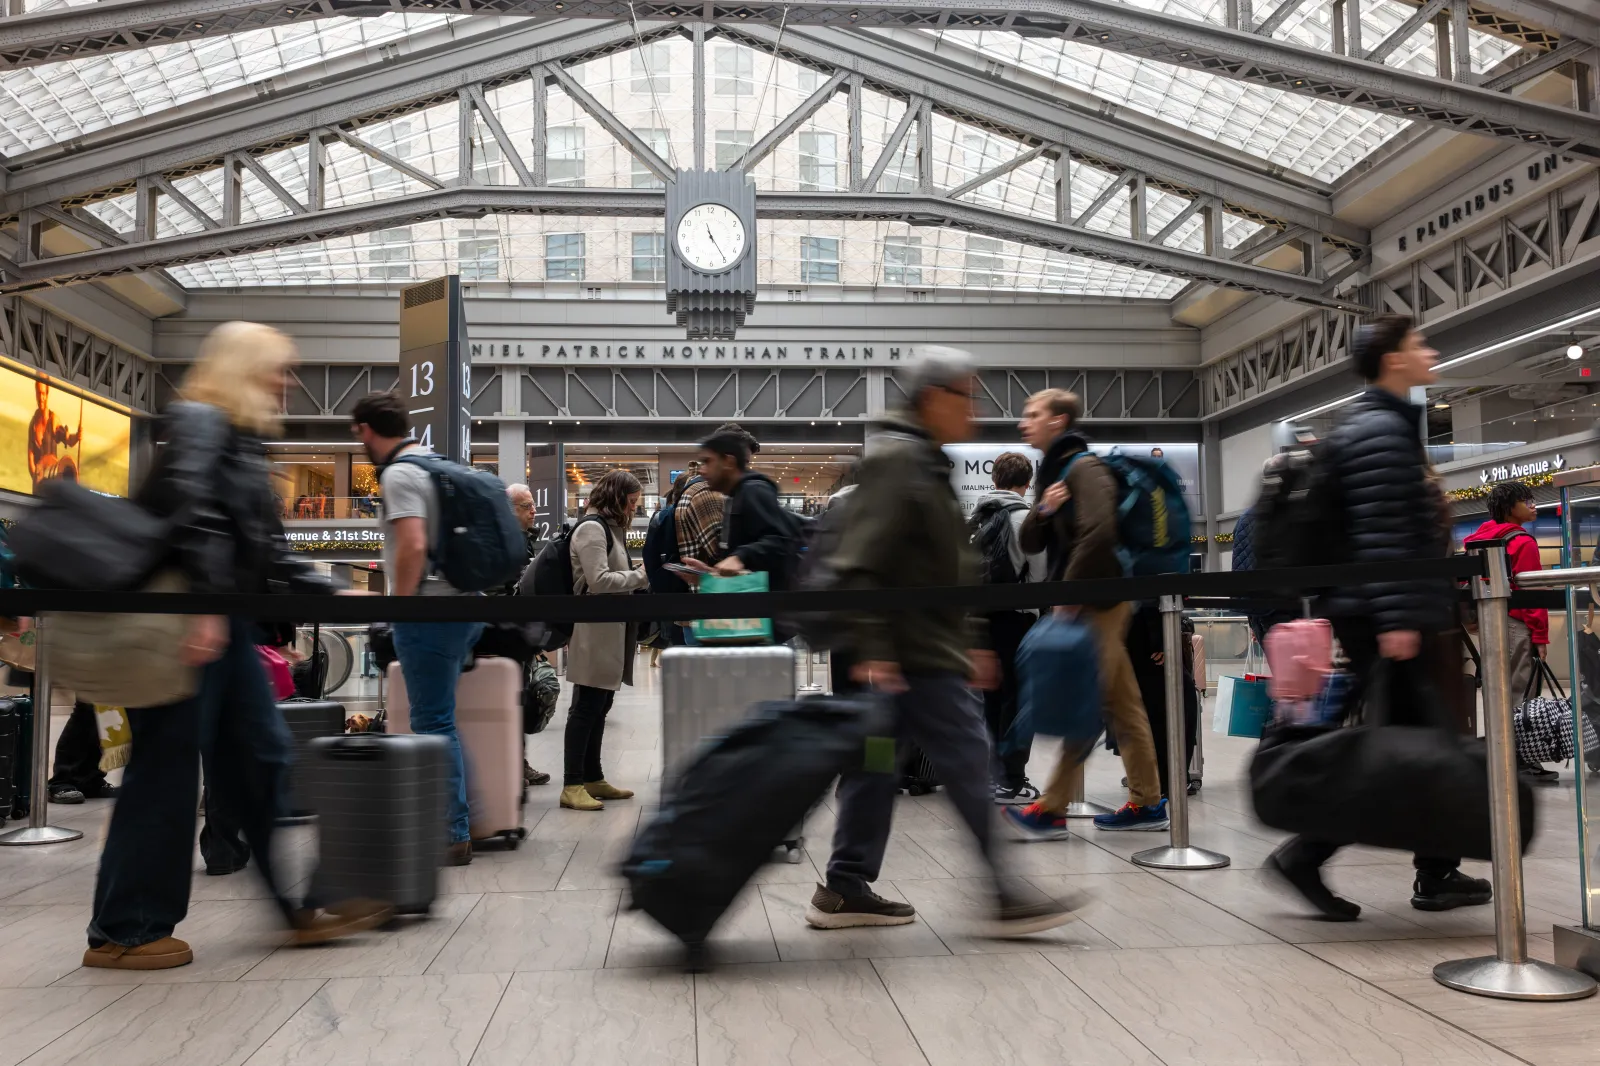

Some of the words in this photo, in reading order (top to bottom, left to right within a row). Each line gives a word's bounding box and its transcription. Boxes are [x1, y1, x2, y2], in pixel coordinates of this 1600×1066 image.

[1398, 236, 1407, 251] E
[1416, 178, 1514, 243] PLURIBUS
[542, 345, 645, 358] PATRICK
[662, 346, 787, 360] MOYNIHAN
[804, 347, 873, 360] TRAIN
[410, 361, 434, 398] 13
[462, 362, 471, 399] 13
[462, 424, 471, 462] 14
[1492, 466, 1508, 481] 9th
[1511, 460, 1549, 478] Avenue
[536, 487, 549, 508] 11
[322, 530, 331, 541] &
[334, 530, 359, 541] 31st
